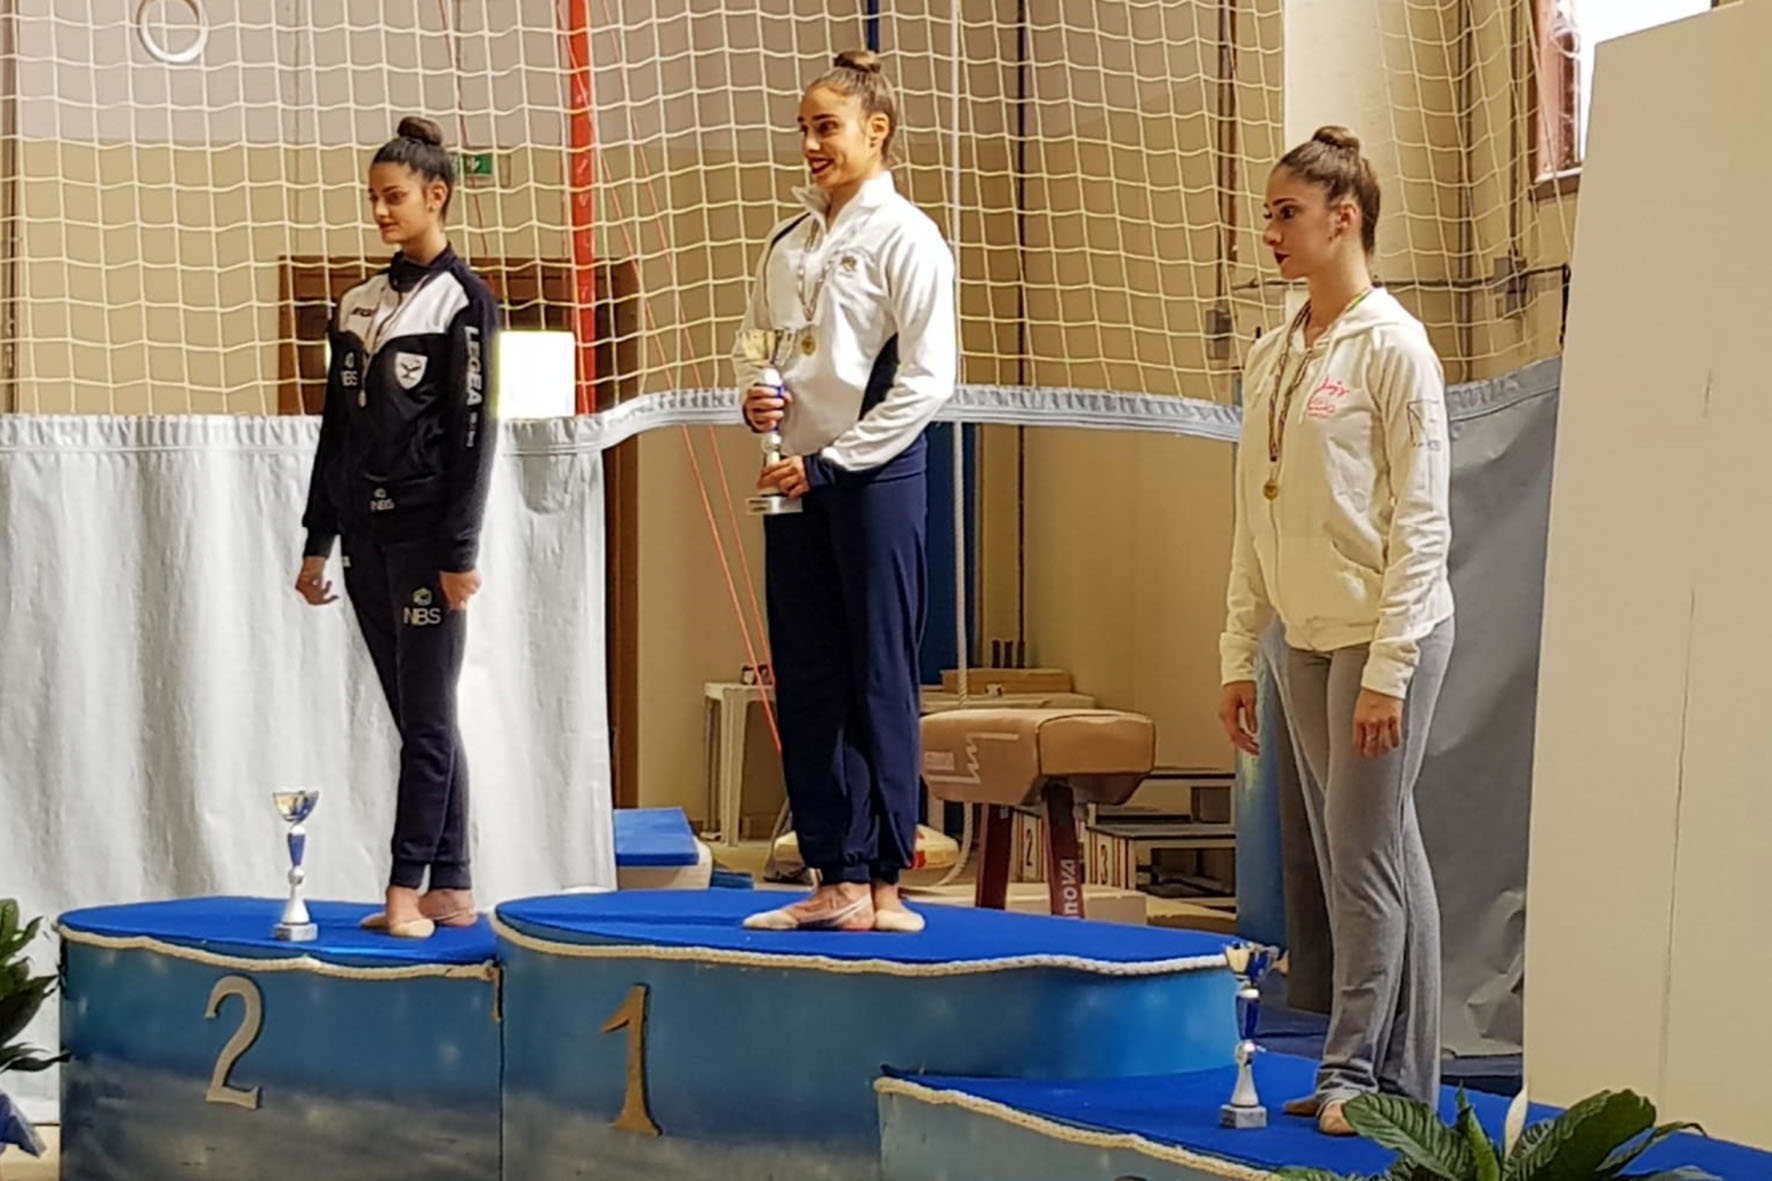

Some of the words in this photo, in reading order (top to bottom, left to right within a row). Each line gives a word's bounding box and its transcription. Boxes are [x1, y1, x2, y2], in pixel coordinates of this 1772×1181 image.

[464, 325, 483, 406] LEGEA
[403, 606, 442, 626] NBS
[204, 974, 265, 1110] 2
[602, 982, 661, 1137] 1
